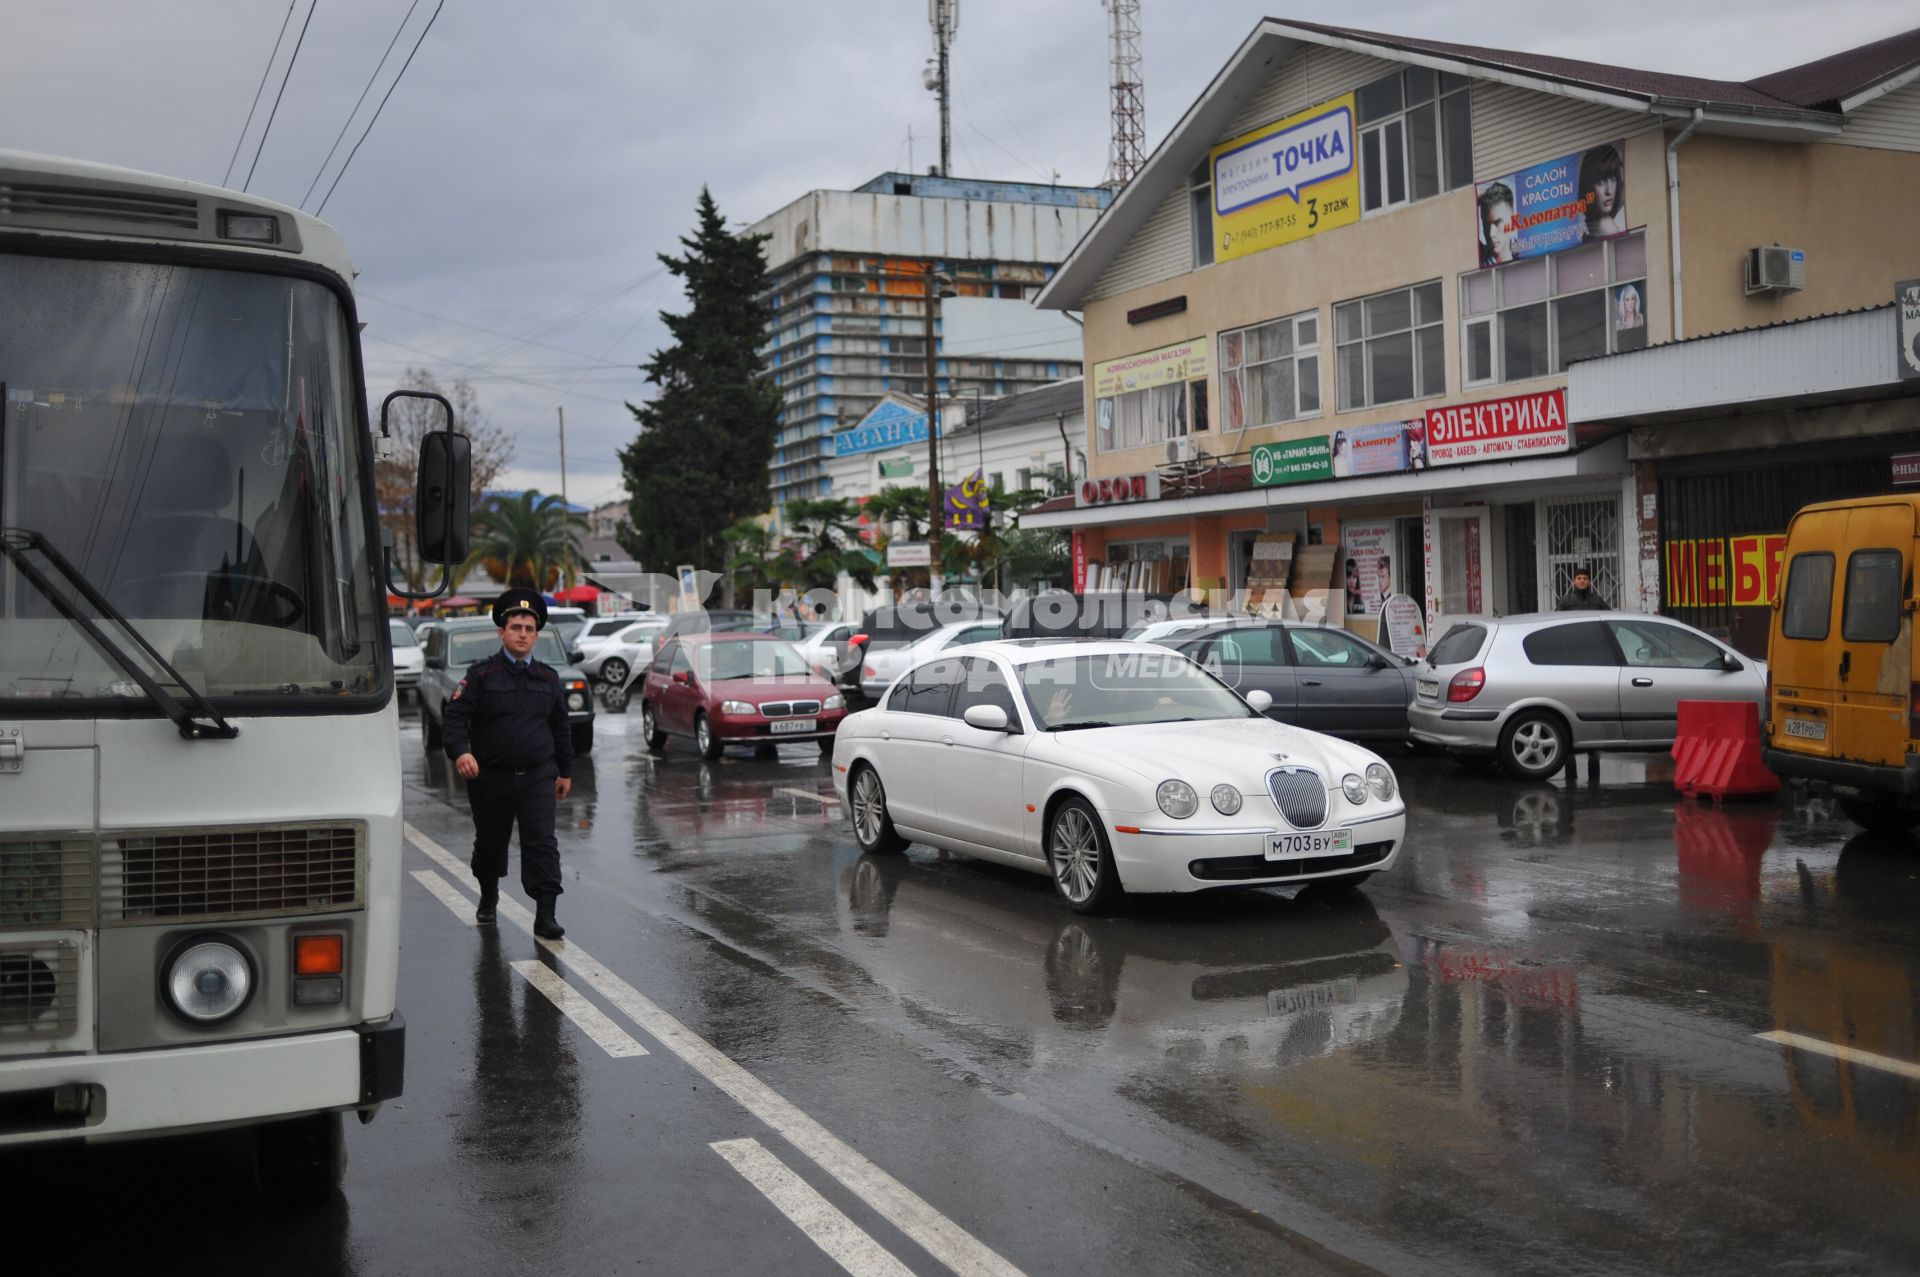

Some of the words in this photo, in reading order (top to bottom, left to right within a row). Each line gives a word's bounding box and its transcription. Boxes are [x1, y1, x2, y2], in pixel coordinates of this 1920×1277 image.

[1272, 129, 1344, 176] ТОЧКА
[1525, 166, 1567, 188] САЛОН
[1522, 181, 1573, 207] КРАСОТЫ
[1306, 198, 1318, 229] 3
[1323, 197, 1349, 216] этаж
[1432, 395, 1562, 441] ЭЛЕКТРИКА
[1431, 448, 1453, 460] ПРОВОД
[1456, 445, 1478, 457] КАБЕЛЬ
[1483, 440, 1513, 454] АВТОМАТЫ
[1517, 434, 1567, 450] СТАБИЛИЗАТОРЫ
[1082, 475, 1147, 504] ОБОИ
